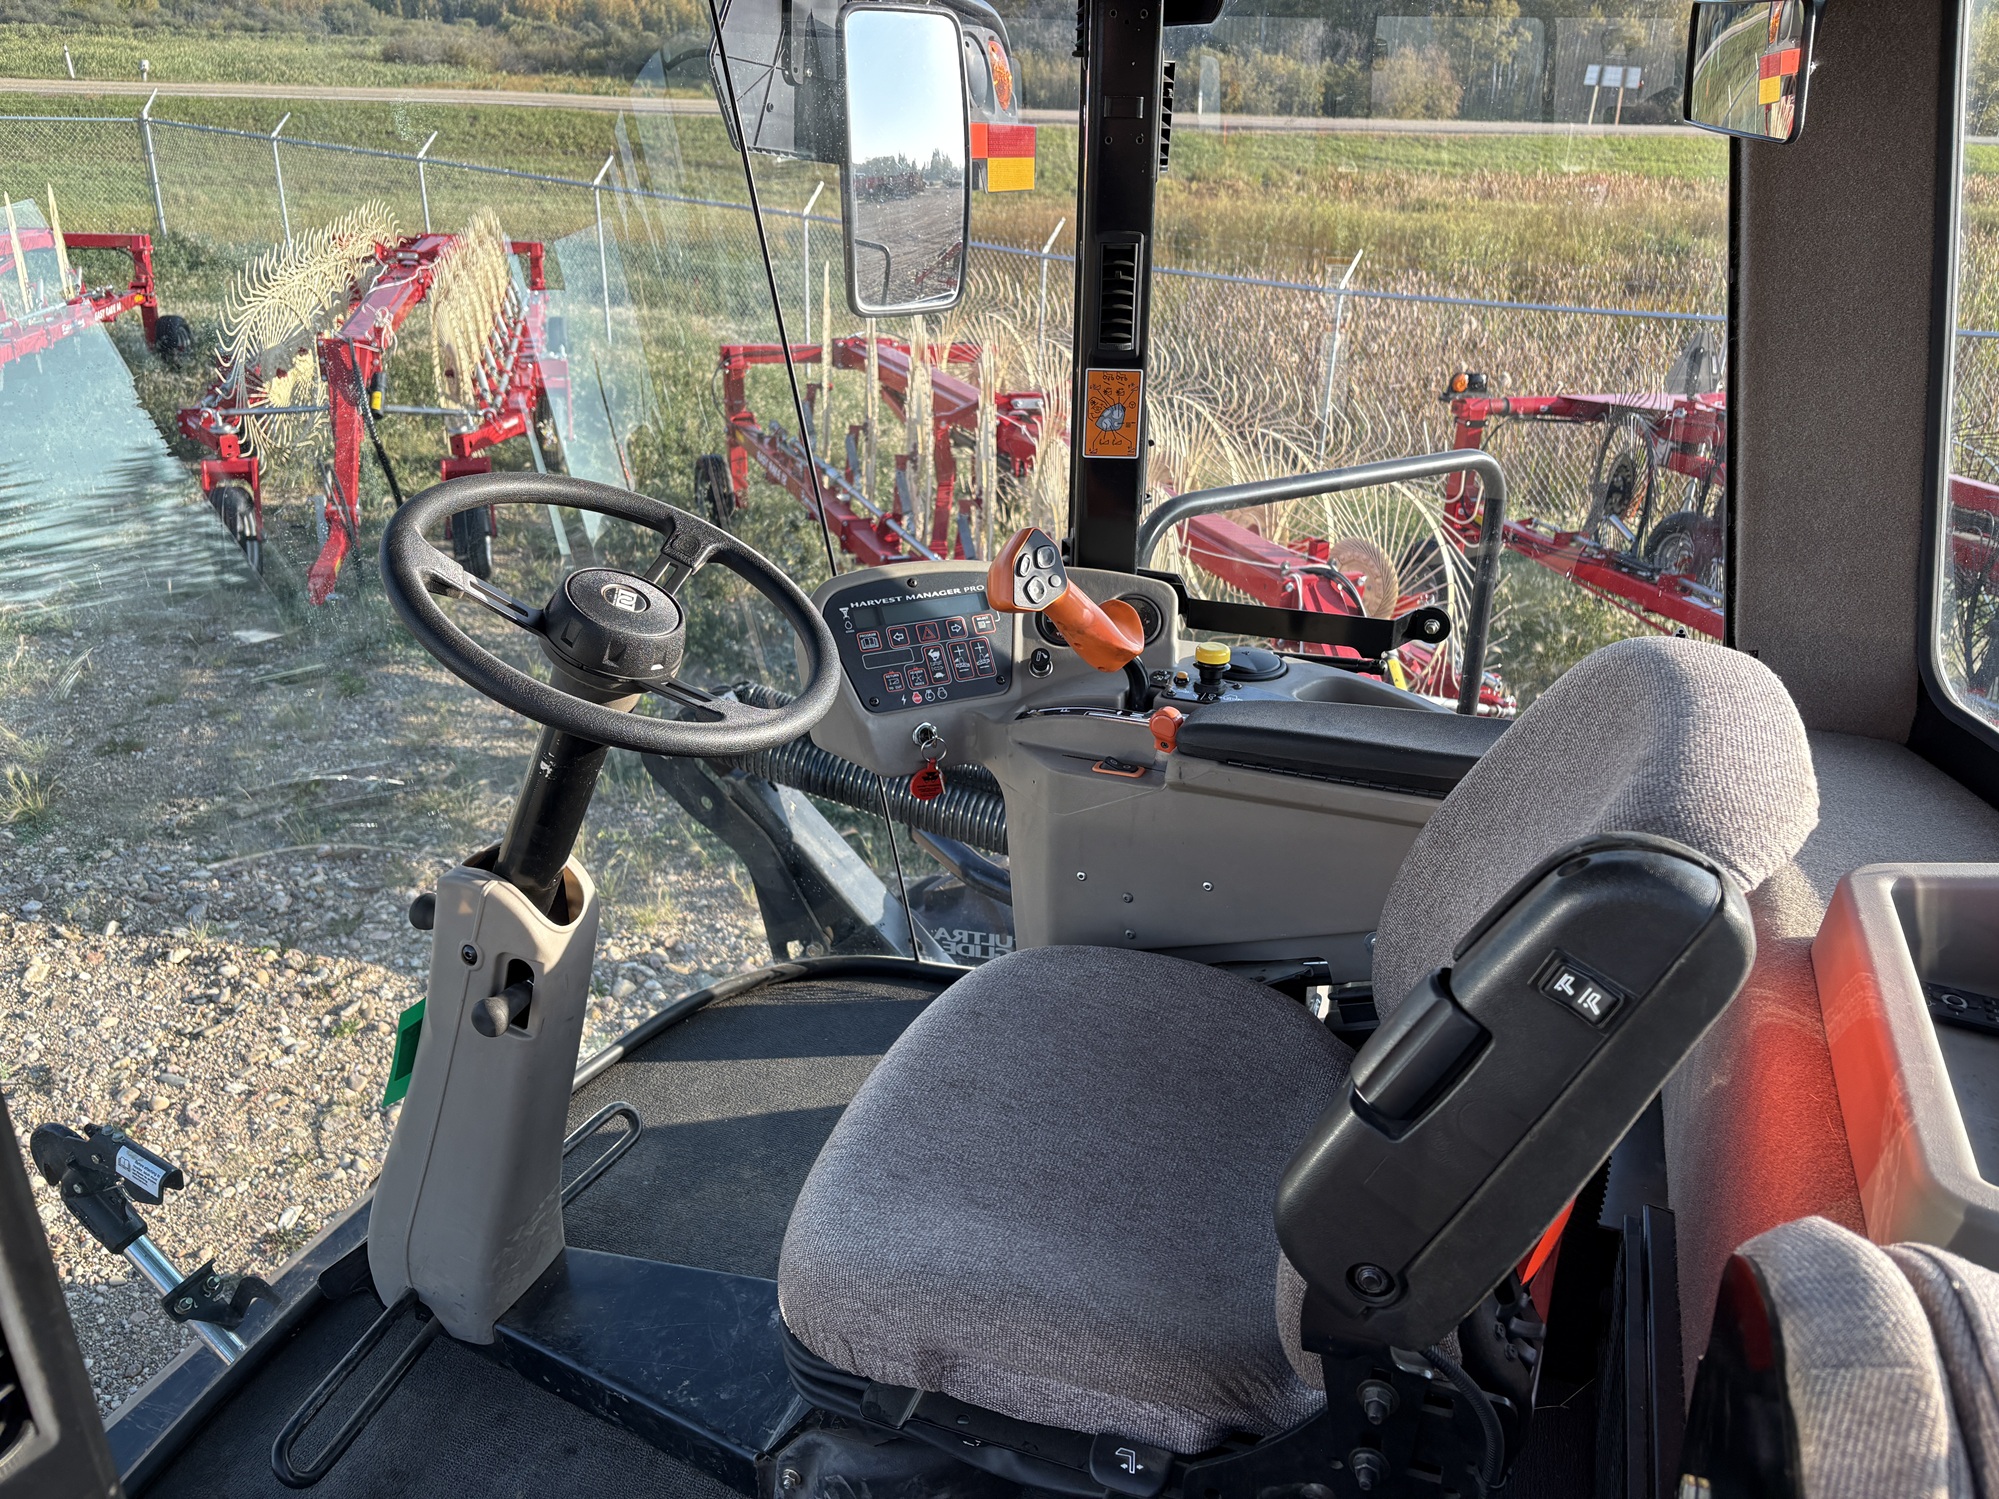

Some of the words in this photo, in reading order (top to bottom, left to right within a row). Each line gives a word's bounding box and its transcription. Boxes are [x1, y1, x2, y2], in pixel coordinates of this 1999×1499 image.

[850, 596, 903, 608] HARVEST
[906, 588, 962, 601] MANAGER
[963, 584, 985, 593] PRO
